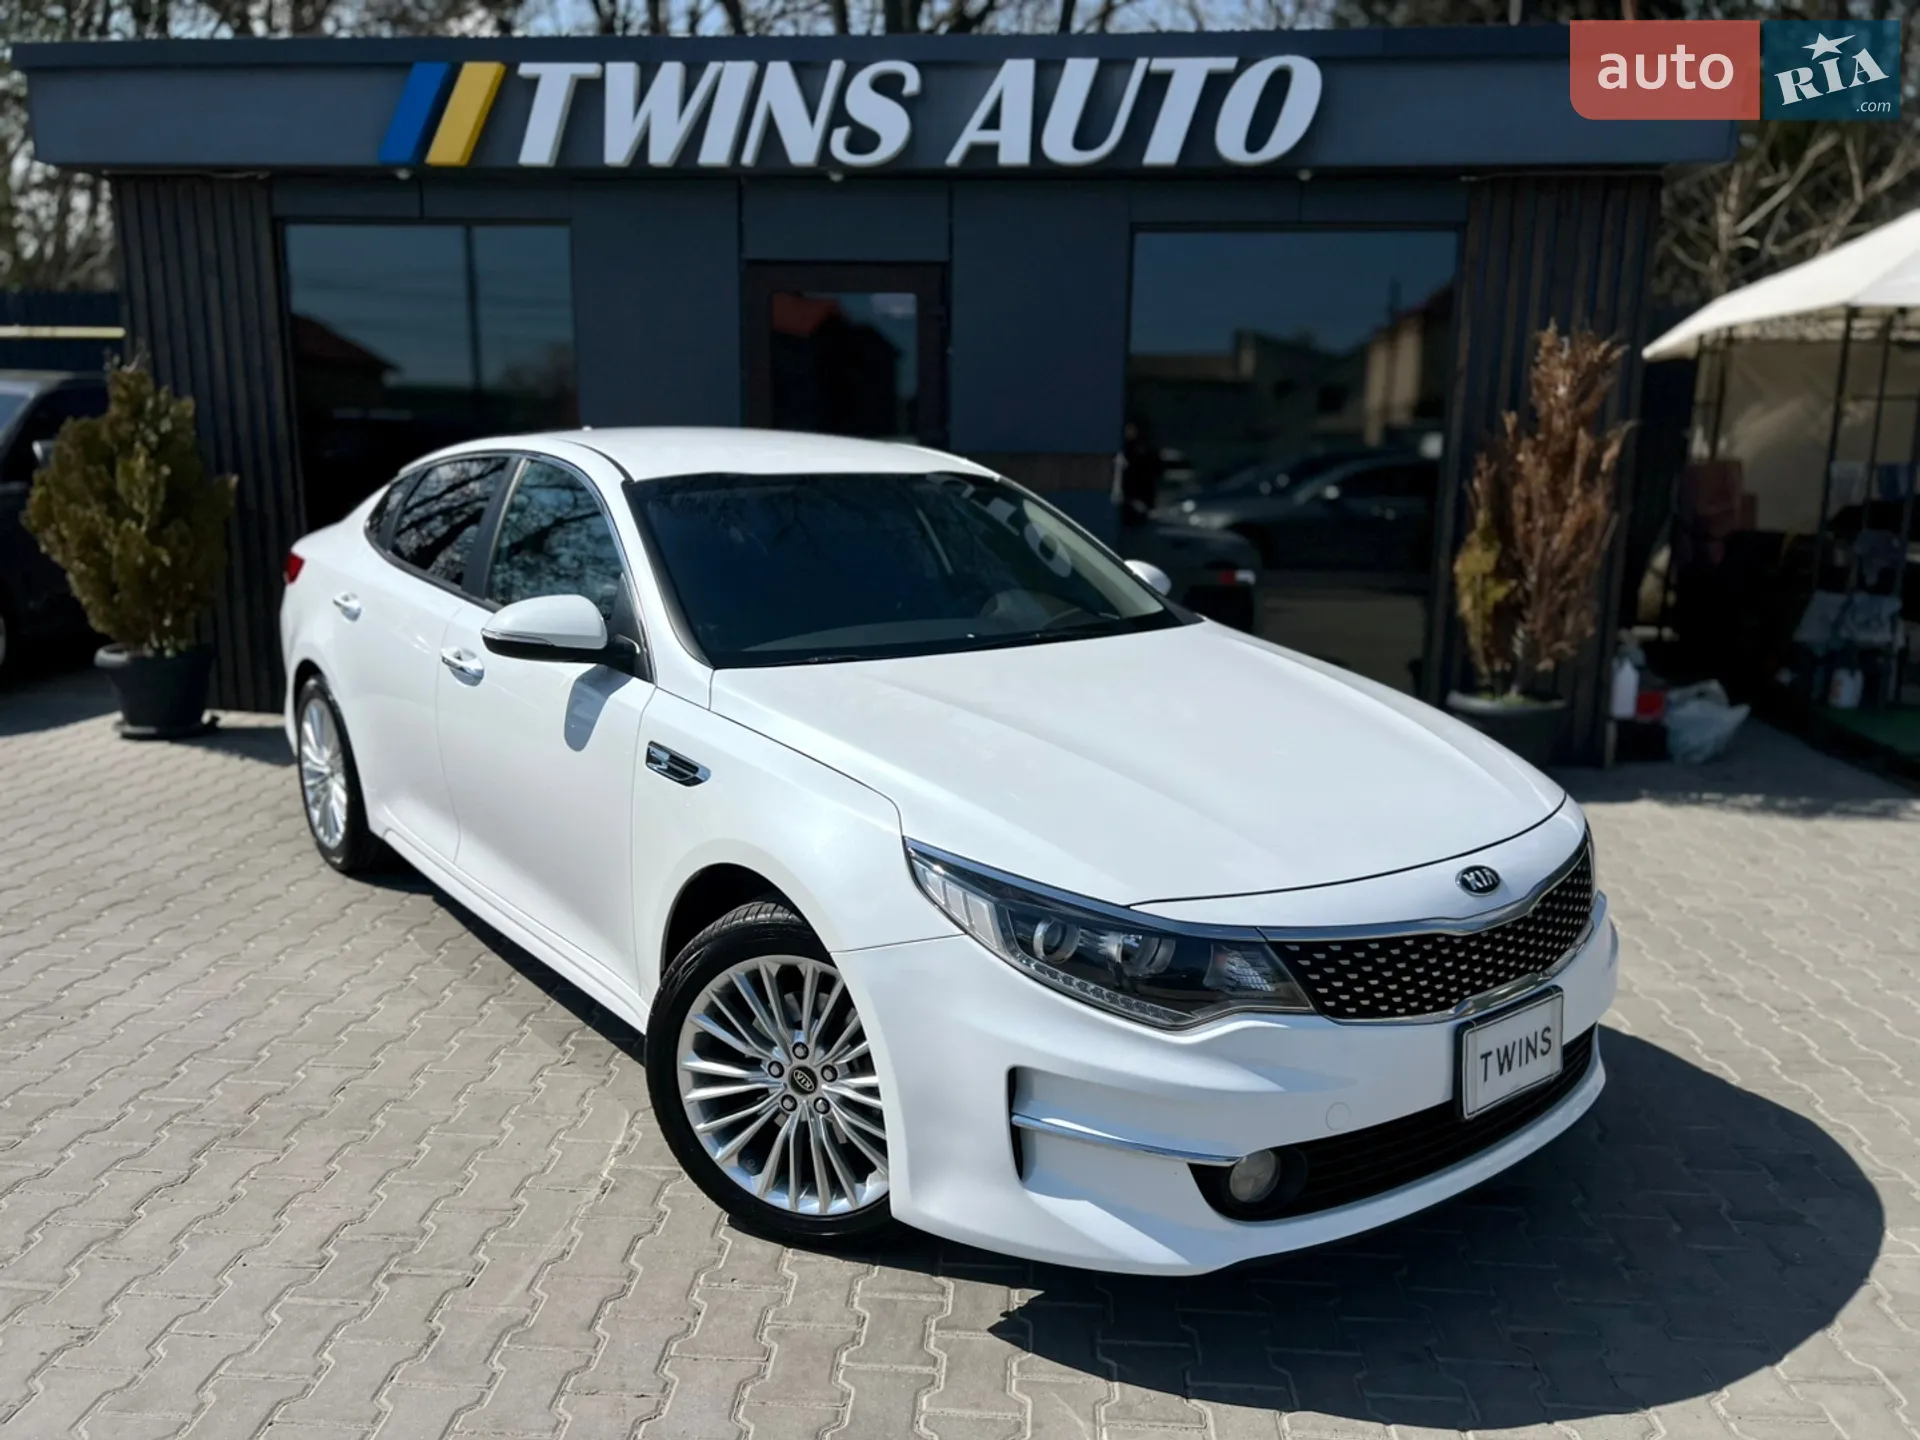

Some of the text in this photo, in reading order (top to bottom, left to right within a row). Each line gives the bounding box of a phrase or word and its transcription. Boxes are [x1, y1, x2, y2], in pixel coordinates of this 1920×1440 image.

[517, 54, 1322, 167] TWINS AUTO
[1462, 868, 1498, 891] KIA
[1480, 1026, 1552, 1083] TWINS
[795, 1071, 813, 1089] KIA
